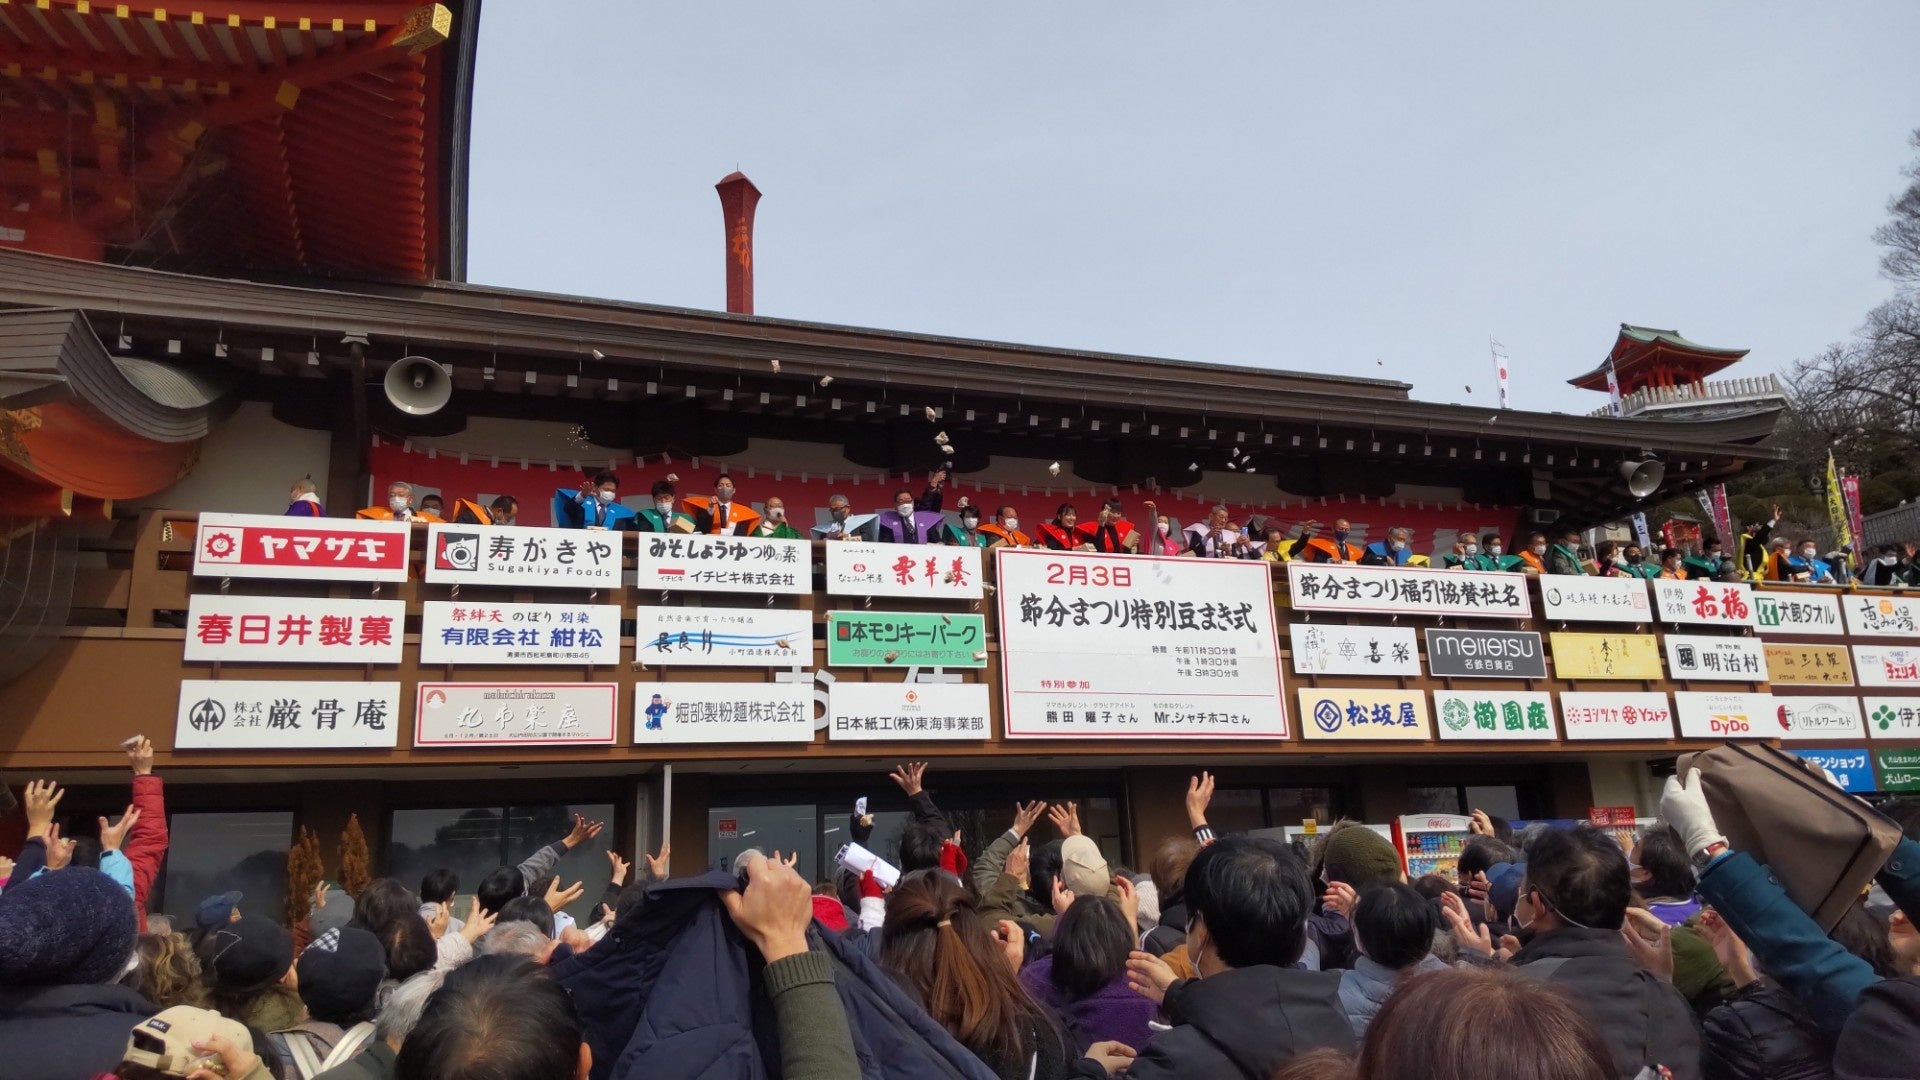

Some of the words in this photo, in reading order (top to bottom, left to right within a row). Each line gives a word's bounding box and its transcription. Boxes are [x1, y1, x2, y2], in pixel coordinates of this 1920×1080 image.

[260, 535, 386, 562] ヤマザキ
[488, 535, 611, 565] 寿がきや
[488, 563, 559, 575] Sugakiya
[566, 566, 611, 577] Foods
[690, 570, 795, 586] イチビキ株式会社
[1047, 563, 1132, 587] 2月3日
[1300, 573, 1520, 607] 節分まつり福引協賛社名
[1663, 587, 1684, 600] 伊勢
[1020, 592, 1258, 633] 節分まつり特別豆まき式
[1667, 602, 1687, 615] 名物
[1692, 585, 1748, 619] 赤福
[512, 610, 552, 623] のぼり
[1779, 601, 1835, 625] 犬飼タオル
[197, 613, 394, 647] 春日井製菓
[441, 627, 540, 646] 有限会社
[550, 627, 604, 648] 紺松
[836, 621, 977, 645] 日本モンキーパーク
[654, 628, 713, 655] 長良川
[1464, 659, 1514, 671] 名鉄百貨店
[1702, 652, 1759, 673] 明治村
[1885, 662, 1918, 679] チェリオ
[1040, 680, 1090, 689] 特別参加
[836, 716, 984, 731] 日本紙工(株)東海事業部
[1346, 699, 1419, 728] 松坂屋
[1802, 716, 1852, 727] リトルワールド
[1710, 719, 1750, 735] DyDo
